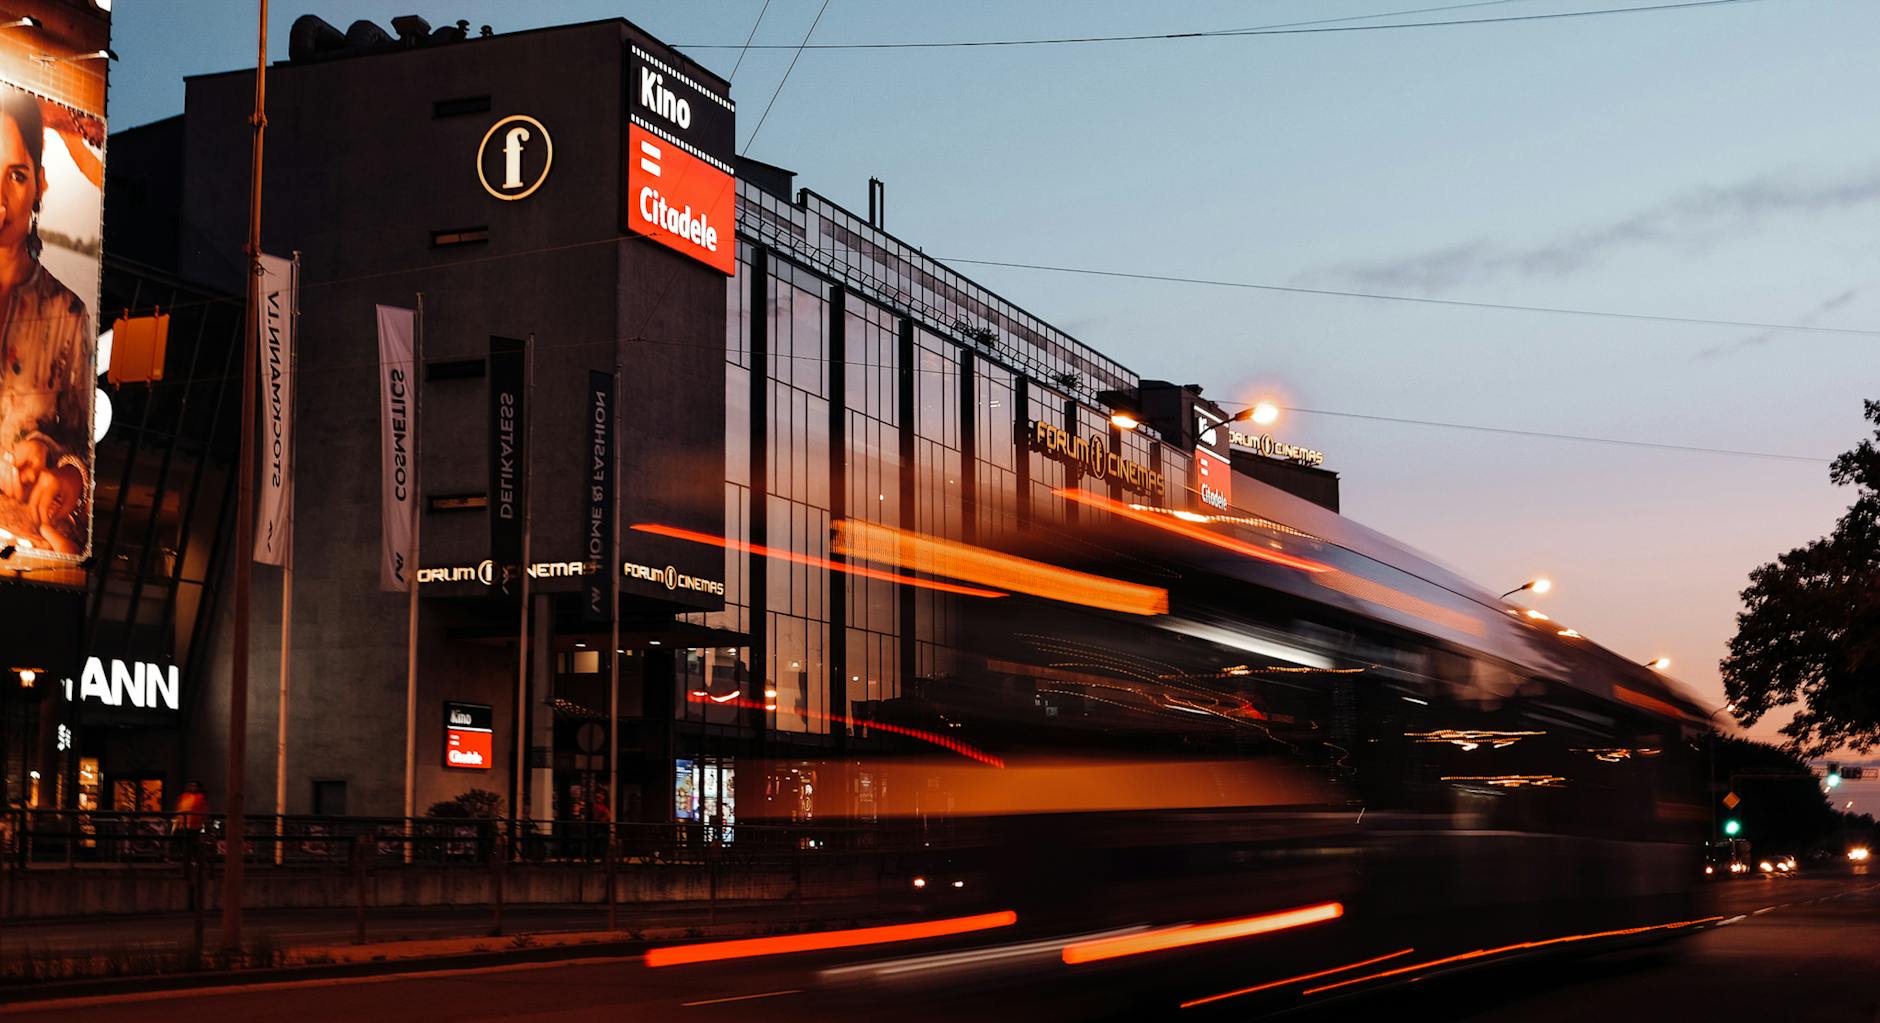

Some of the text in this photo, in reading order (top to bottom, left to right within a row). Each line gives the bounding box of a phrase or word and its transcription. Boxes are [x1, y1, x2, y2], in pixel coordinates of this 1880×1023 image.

[641, 66, 691, 130] Kino
[503, 127, 530, 189] f
[640, 187, 717, 252] Citadele
[1037, 421, 1089, 464] FORUM
[1108, 452, 1165, 496] CINEMAS
[1229, 431, 1261, 449] ORUM
[1275, 443, 1323, 464] CINEMAS
[416, 567, 475, 583] ORUM
[624, 562, 664, 584] FORUM
[678, 574, 724, 596] CINEMAS
